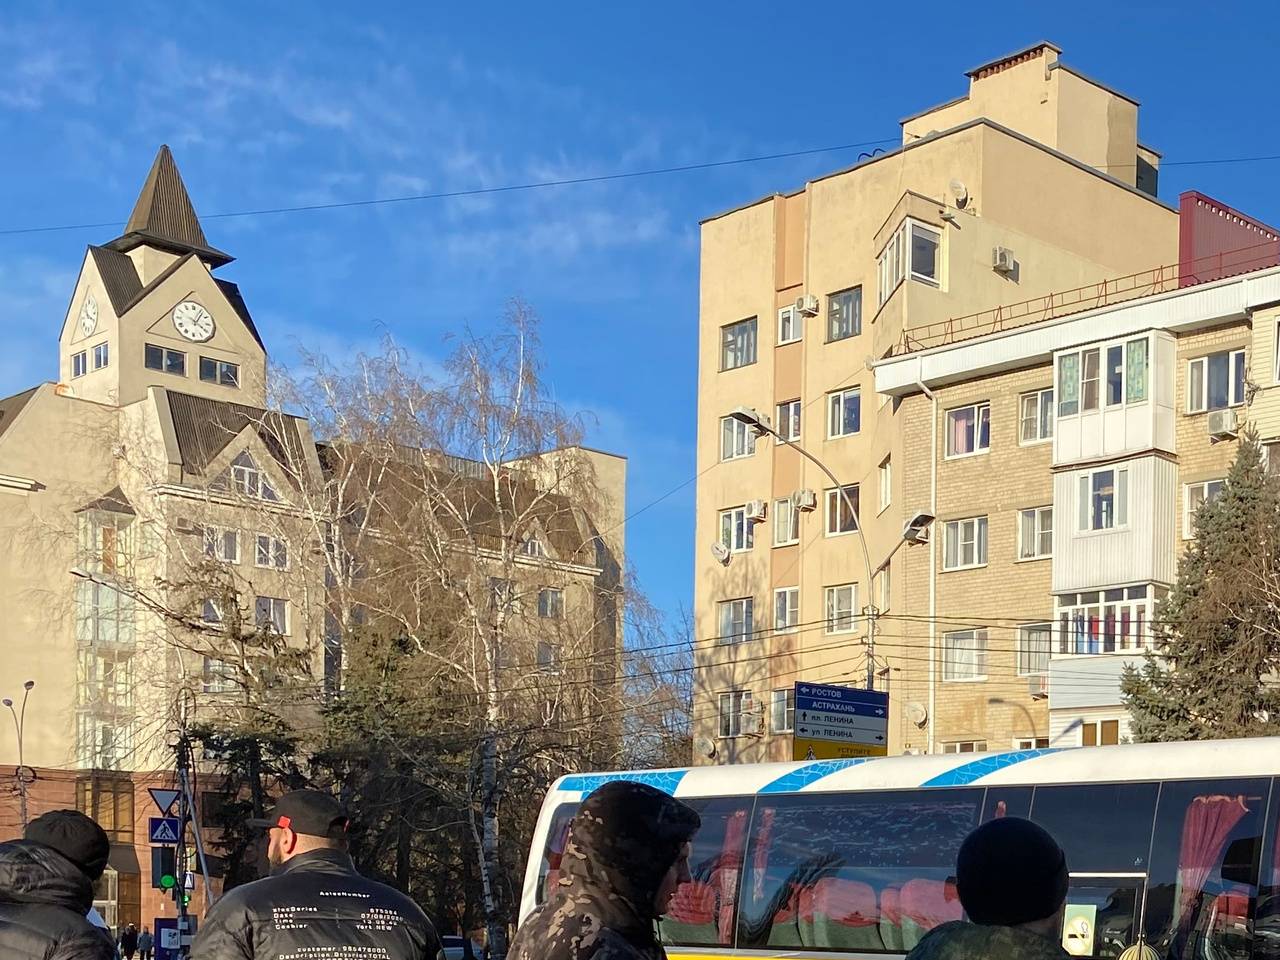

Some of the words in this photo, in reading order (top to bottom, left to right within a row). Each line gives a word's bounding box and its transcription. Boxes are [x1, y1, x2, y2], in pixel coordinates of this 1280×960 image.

[811, 687, 842, 698] РОСТОВ
[812, 701, 856, 712] АСТРАХАНЬ
[823, 715, 855, 724] ЛЕНИНА
[823, 728, 854, 738] ЛЕНИНА
